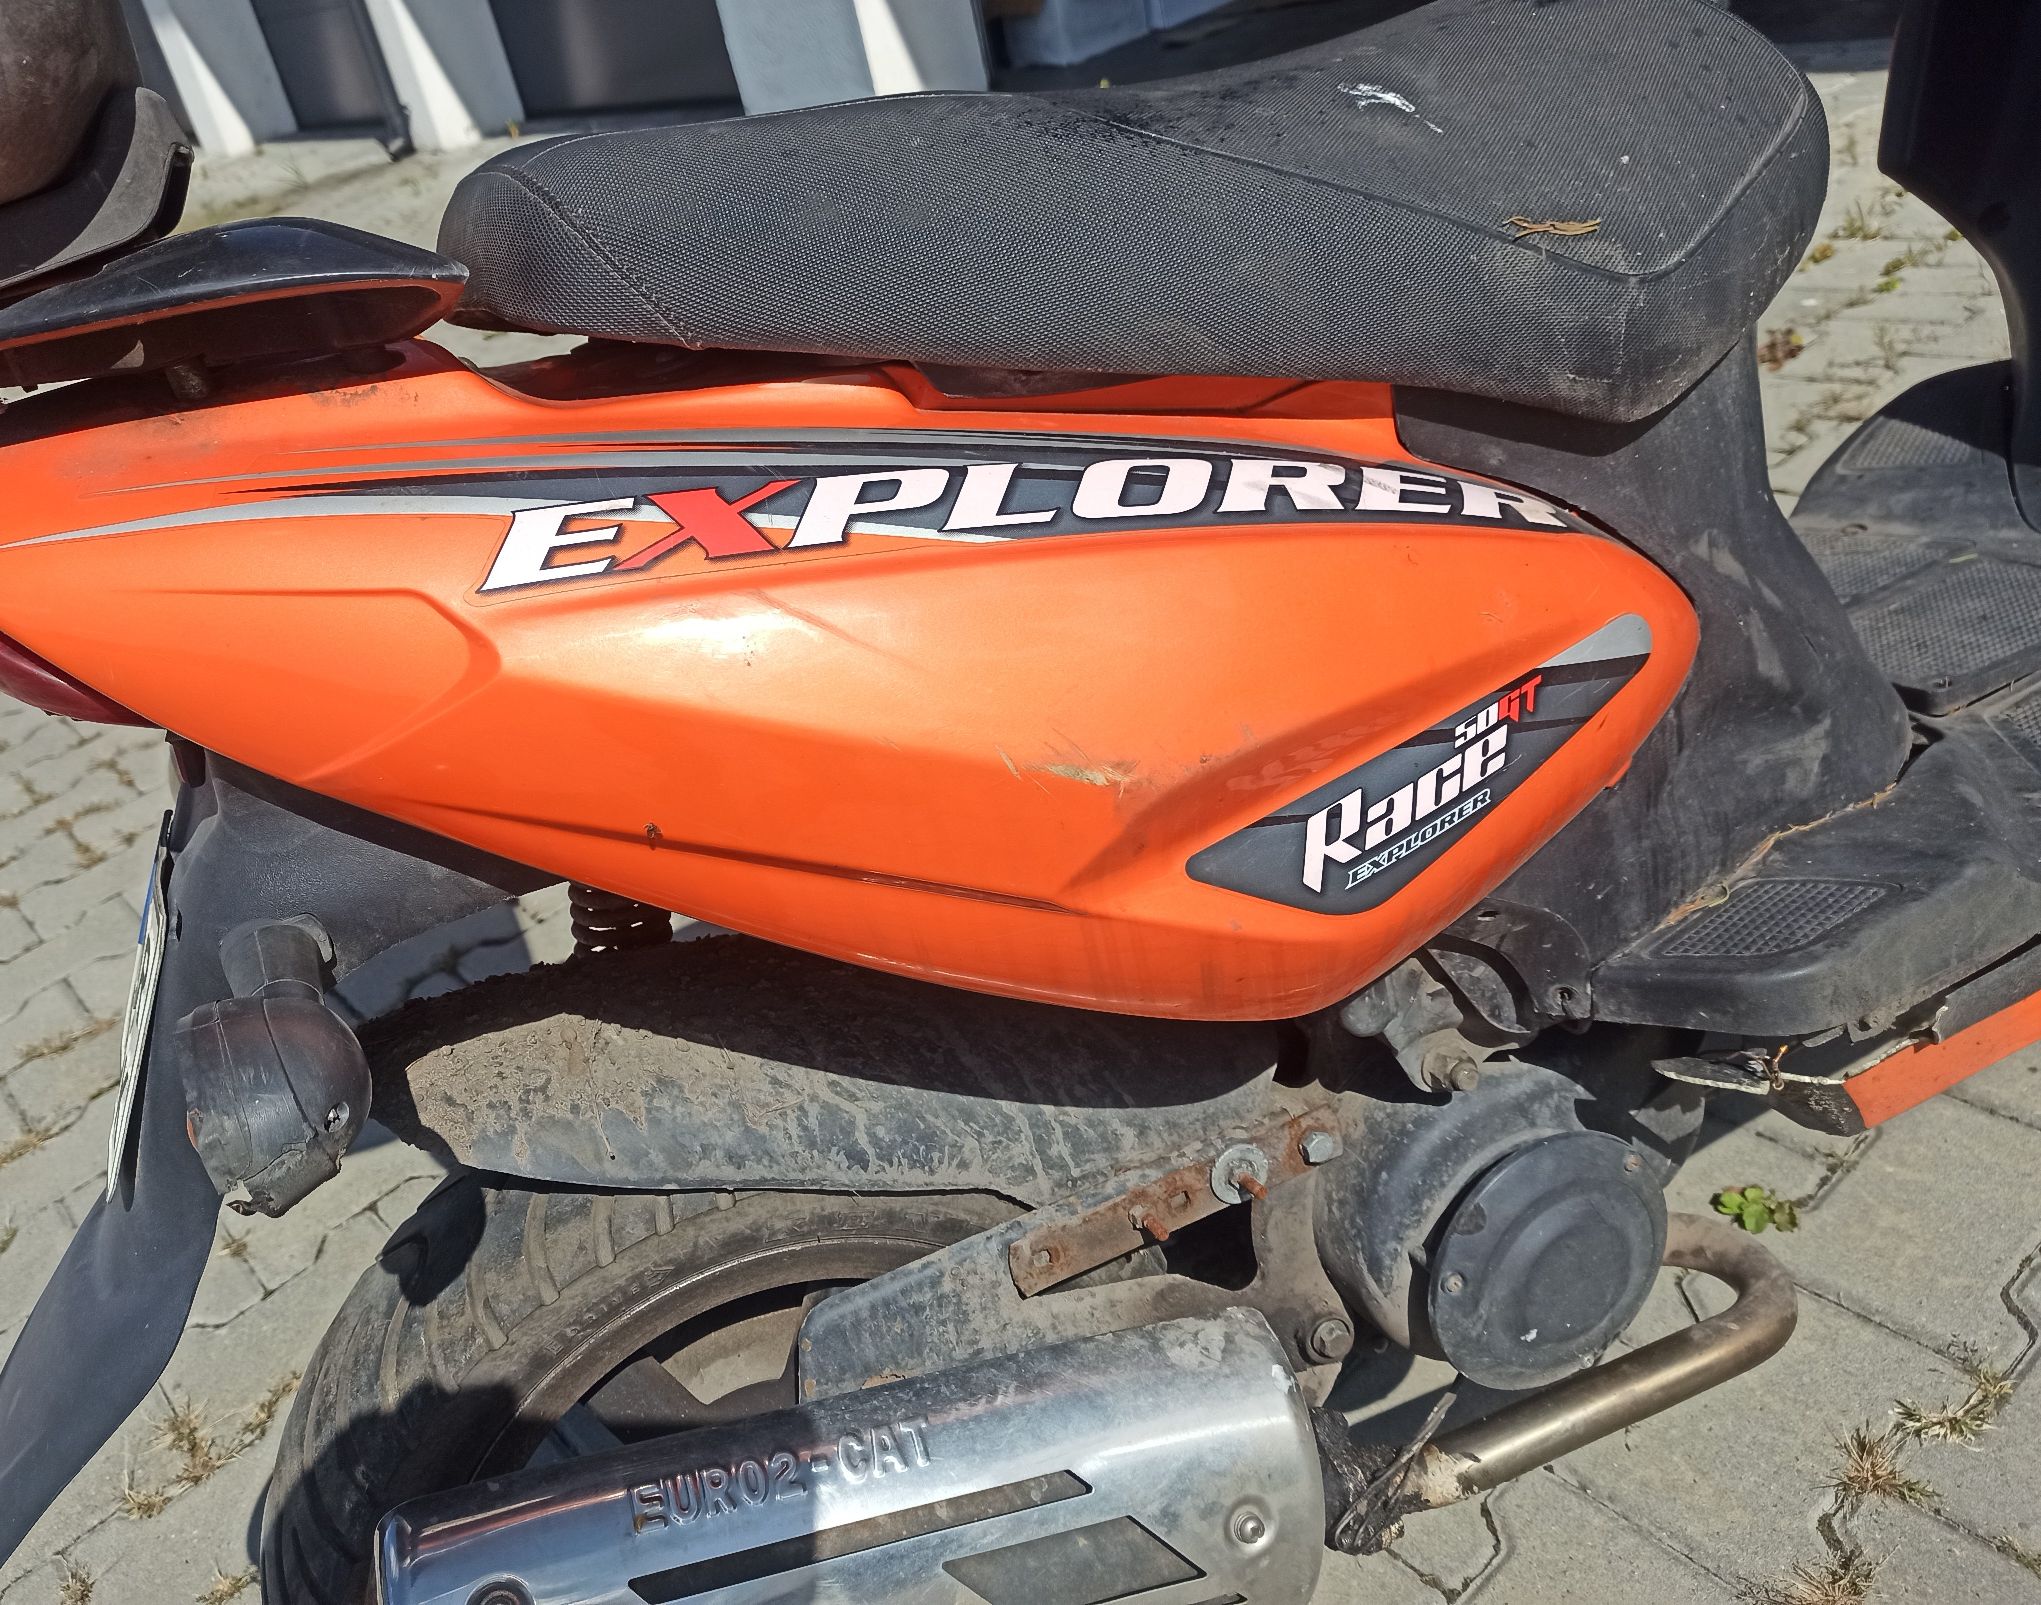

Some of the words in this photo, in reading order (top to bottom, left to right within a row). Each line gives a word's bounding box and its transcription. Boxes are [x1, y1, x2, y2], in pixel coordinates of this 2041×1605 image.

[475, 457, 1568, 593] EXPLORER
[1303, 724, 1508, 893] Race
[1345, 788, 1492, 890] EXPLORER
[629, 1417, 931, 1535] EURO2-CAT
